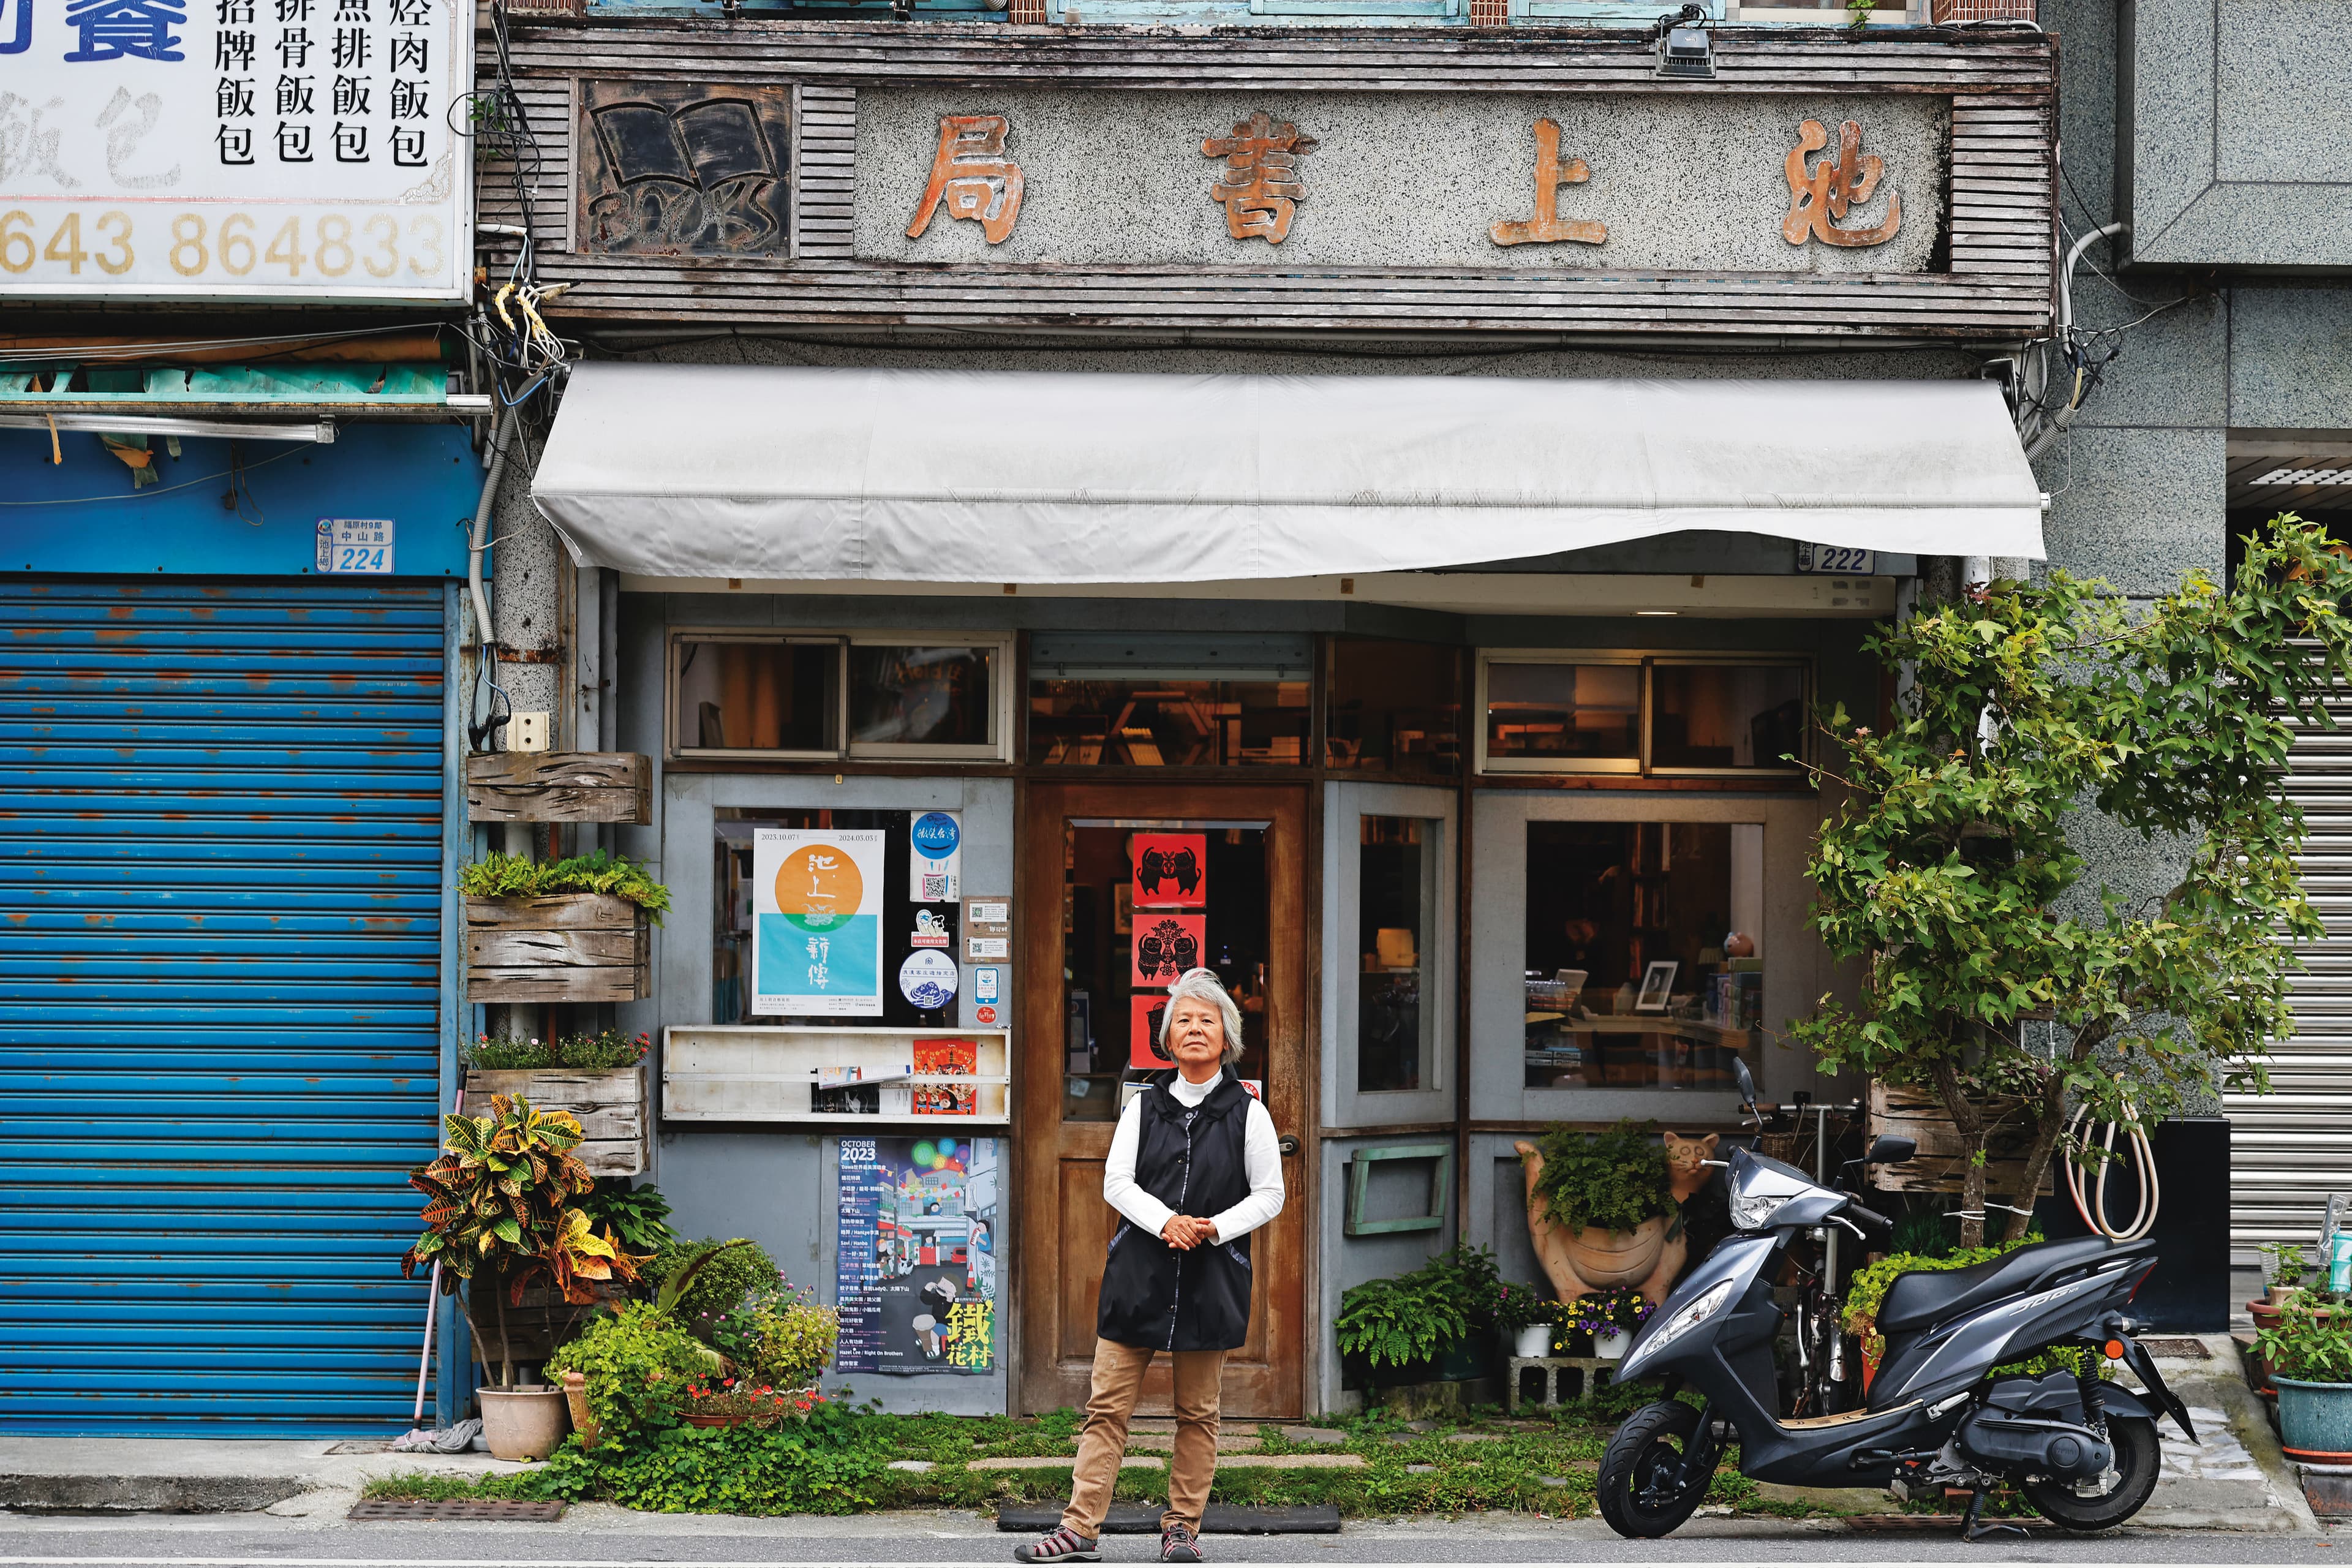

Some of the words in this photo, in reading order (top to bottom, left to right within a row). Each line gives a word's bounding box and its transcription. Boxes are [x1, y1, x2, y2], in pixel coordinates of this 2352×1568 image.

[170, 213, 444, 278] 864833
[342, 532, 384, 542] 中山路
[319, 540, 329, 566] 池上鄉
[340, 548, 384, 570] 224
[1821, 548, 1866, 570] 222
[807, 854, 839, 899] 池上
[841, 1148, 876, 1161] 2023
[2009, 1288, 2070, 1317] JOG
[946, 1344, 988, 1367] 花村
